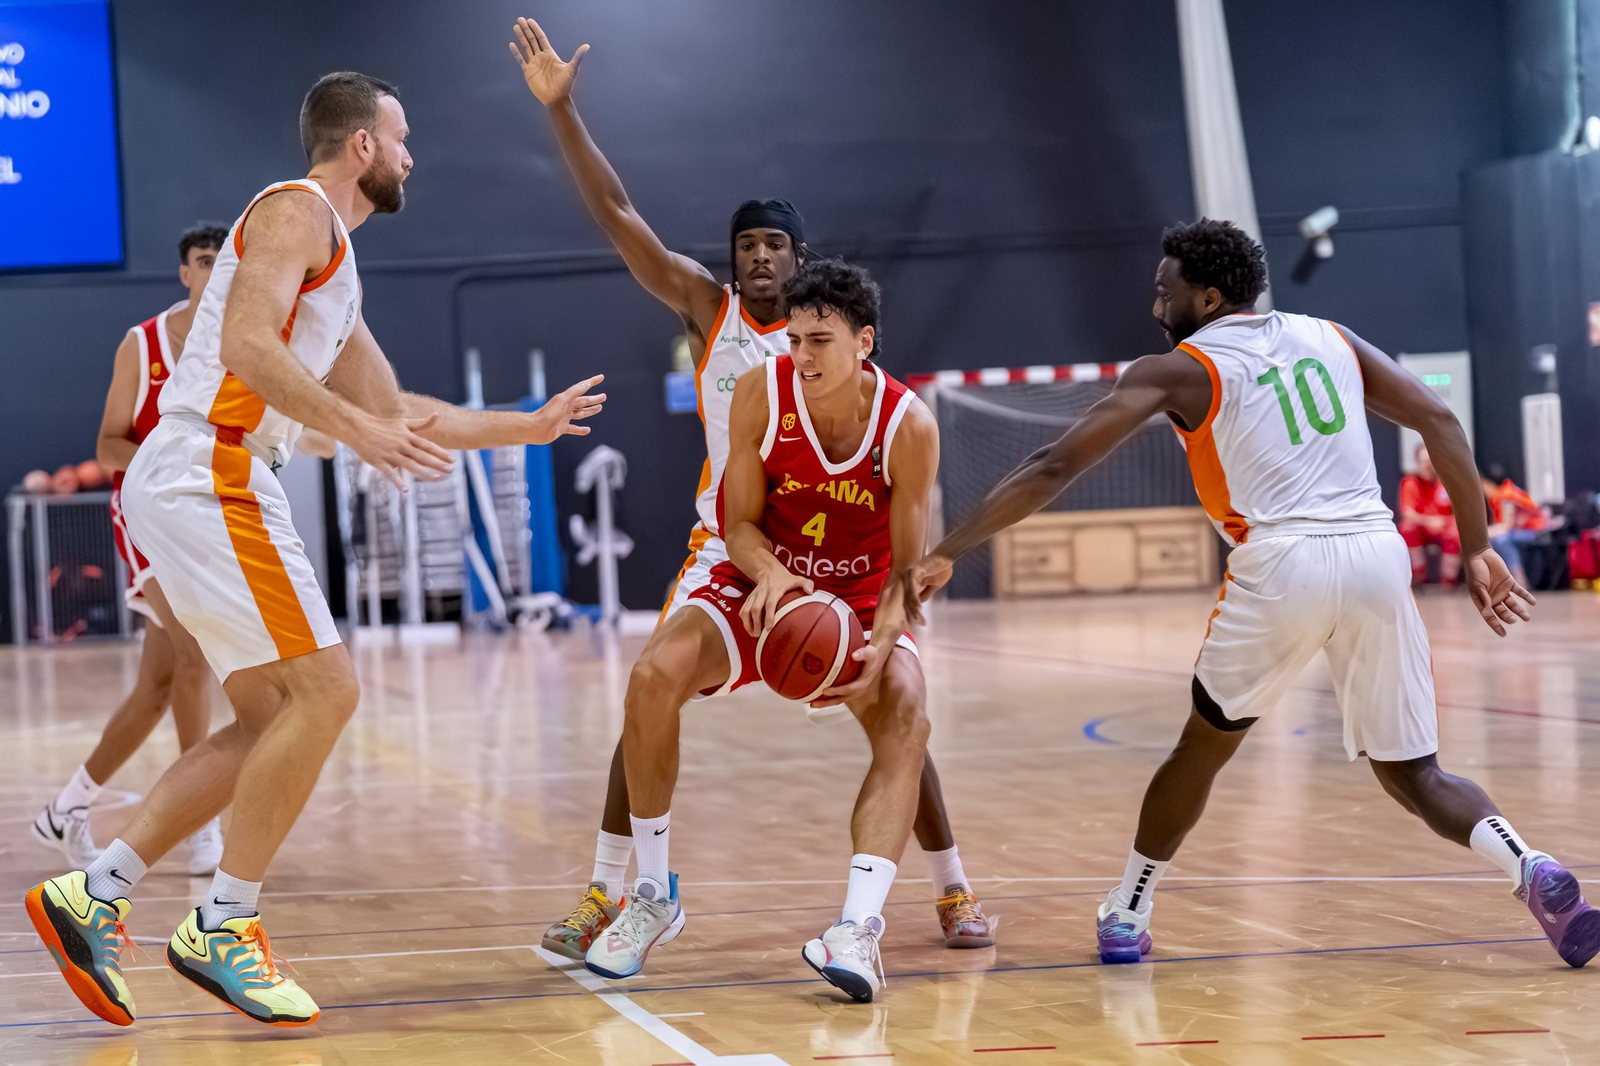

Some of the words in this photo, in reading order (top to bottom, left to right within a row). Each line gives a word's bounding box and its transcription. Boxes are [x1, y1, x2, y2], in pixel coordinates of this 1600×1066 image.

[1257, 357, 1346, 446] 10
[776, 472, 876, 512] SAÑA
[801, 511, 827, 547] 4
[768, 539, 871, 578] ndesa
